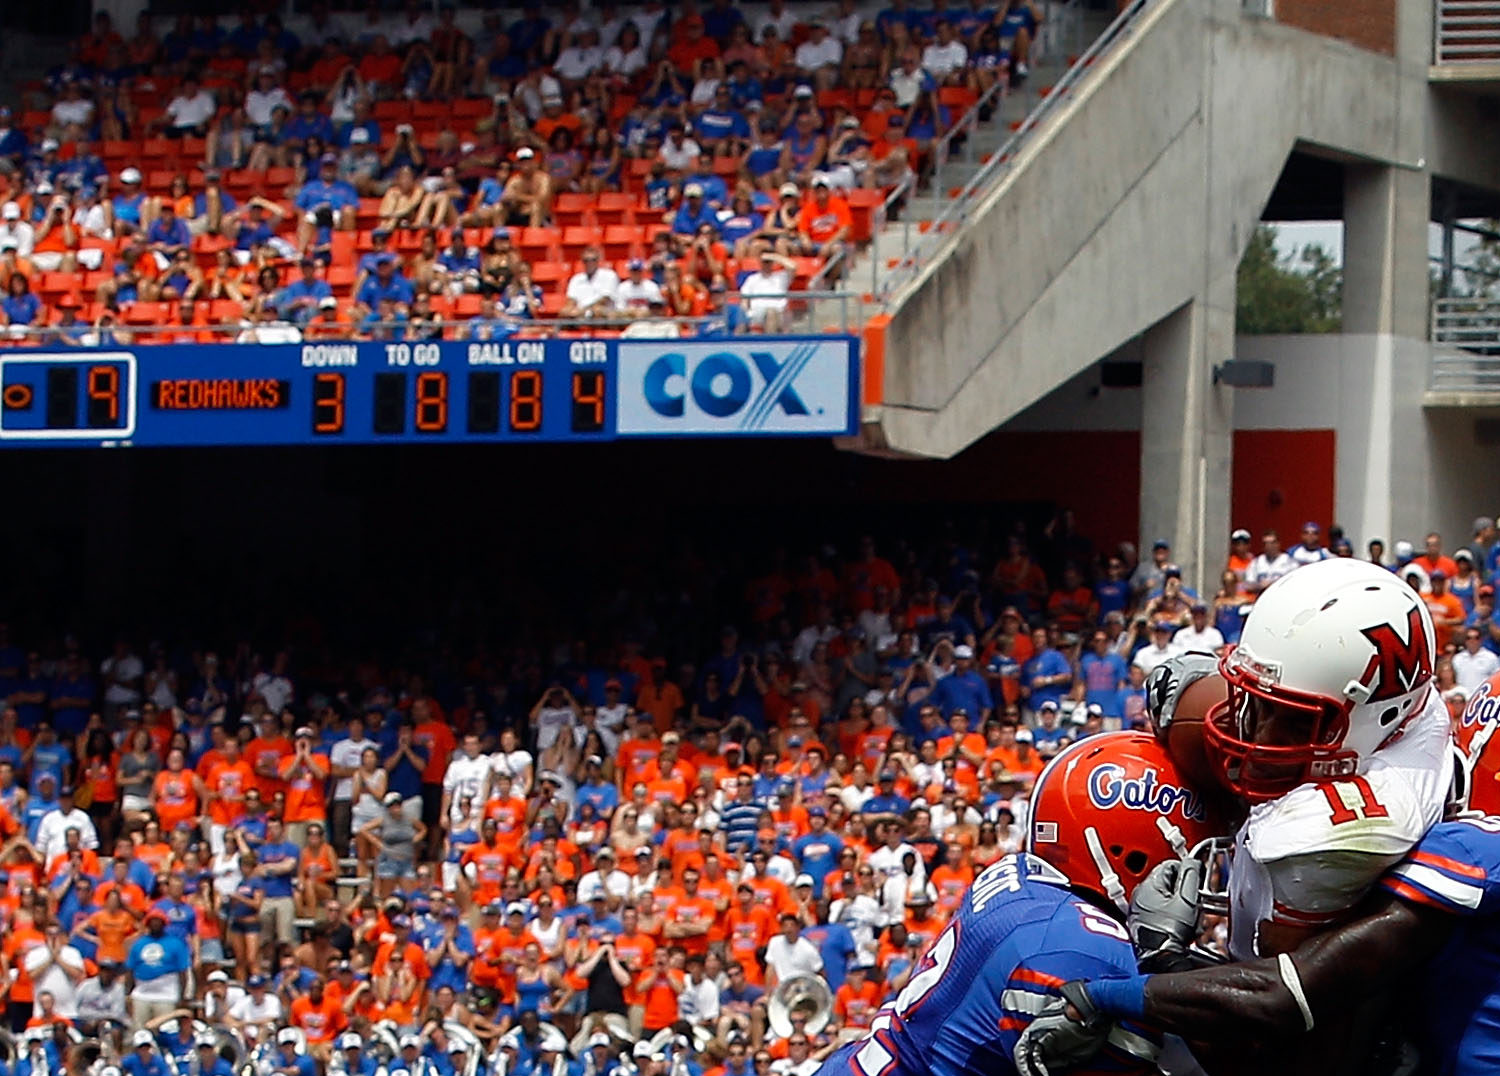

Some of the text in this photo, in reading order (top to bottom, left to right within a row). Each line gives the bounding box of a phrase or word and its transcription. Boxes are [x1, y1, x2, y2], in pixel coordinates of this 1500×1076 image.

[302, 342, 607, 367] DOWN TO GO BALL ON QTR
[88, 365, 603, 431] 9 REDHAWKS 3 8 8 4
[643, 346, 820, 427] COX
[1360, 606, 1433, 705] M
[1087, 763, 1206, 822] Gators
[1315, 775, 1388, 826] 11
